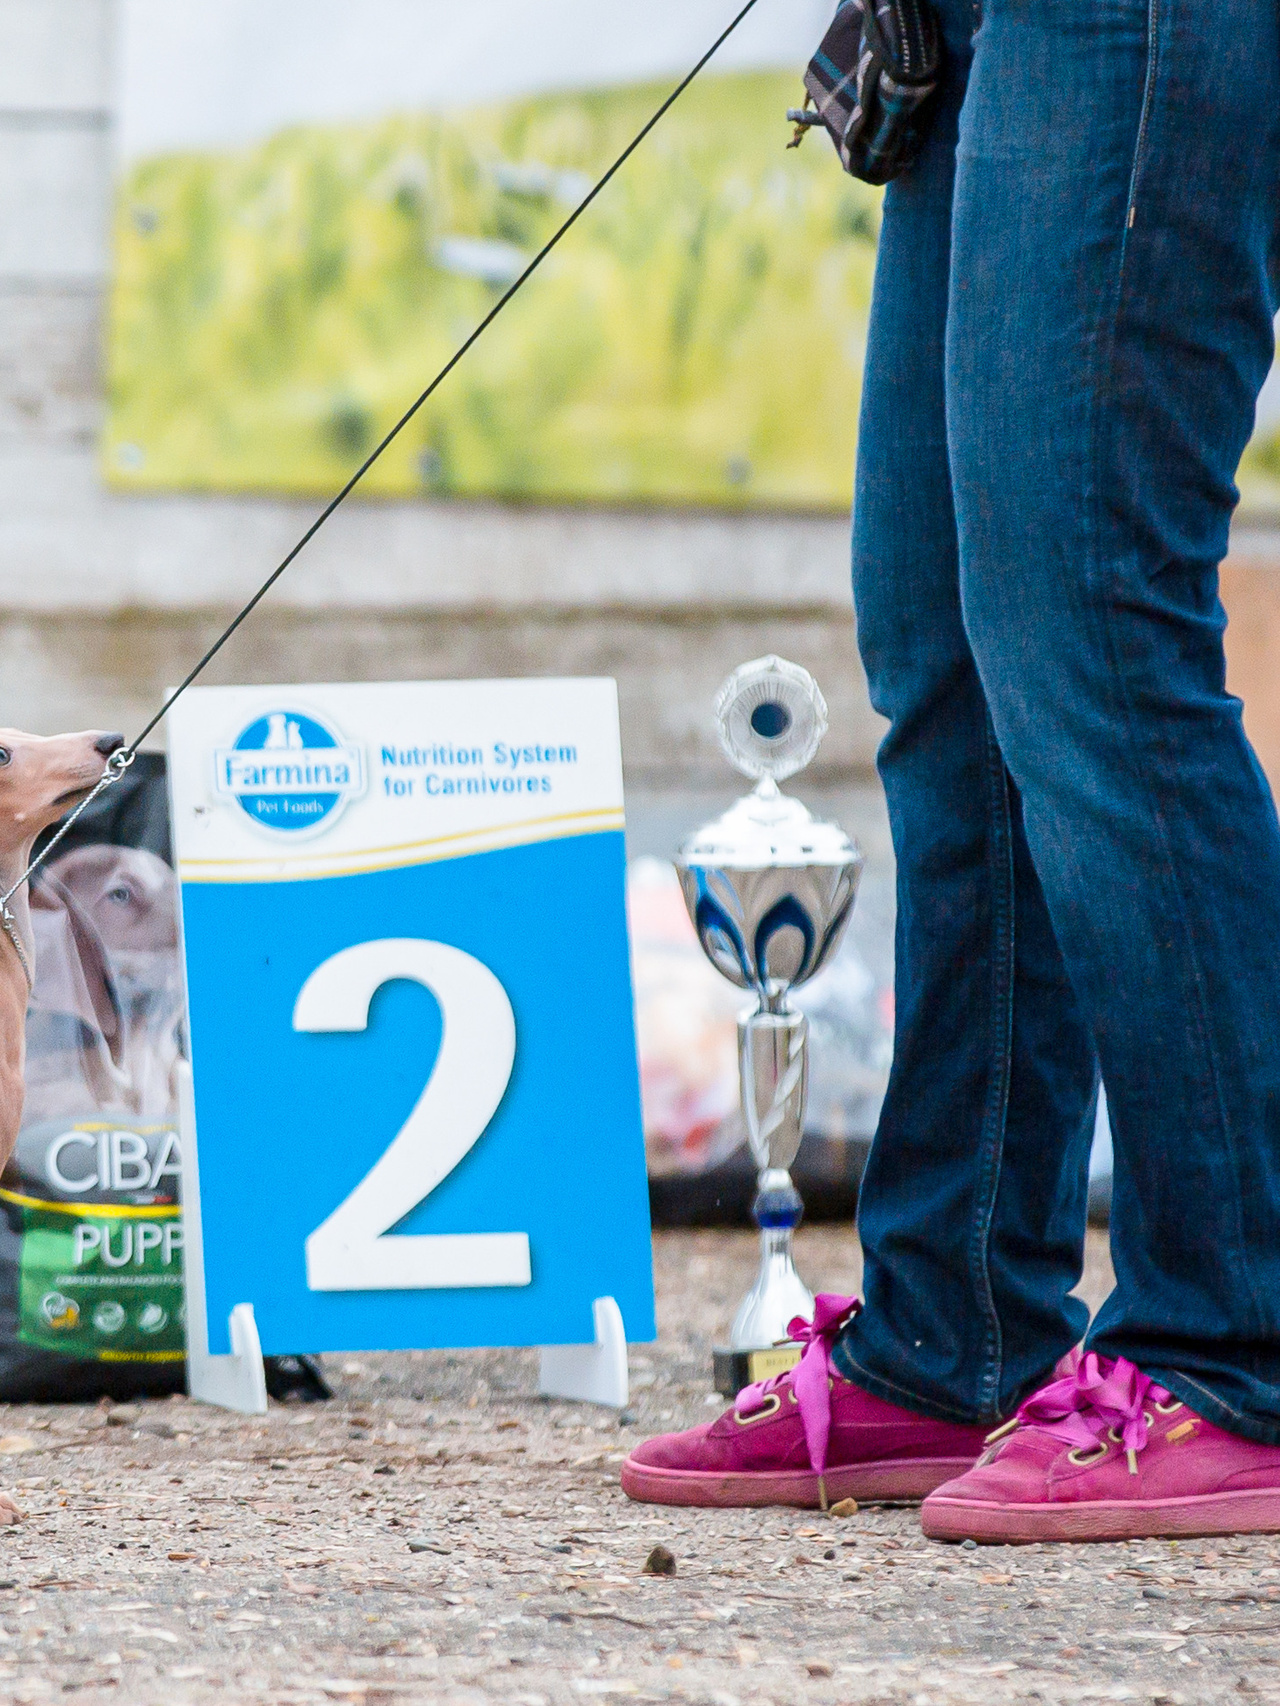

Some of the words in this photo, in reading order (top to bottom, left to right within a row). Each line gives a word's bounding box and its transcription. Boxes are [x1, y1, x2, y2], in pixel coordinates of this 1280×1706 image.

[225, 755, 350, 787] Farmina
[381, 742, 484, 767] Nutrition
[494, 742, 578, 770] System
[384, 774, 415, 797] for
[425, 772, 552, 796] Carnivores
[256, 799, 278, 814] Pet
[283, 798, 324, 814] Foods
[293, 937, 531, 1291] 2
[45, 1130, 183, 1193] CIBA
[74, 1222, 184, 1267] PUPP
